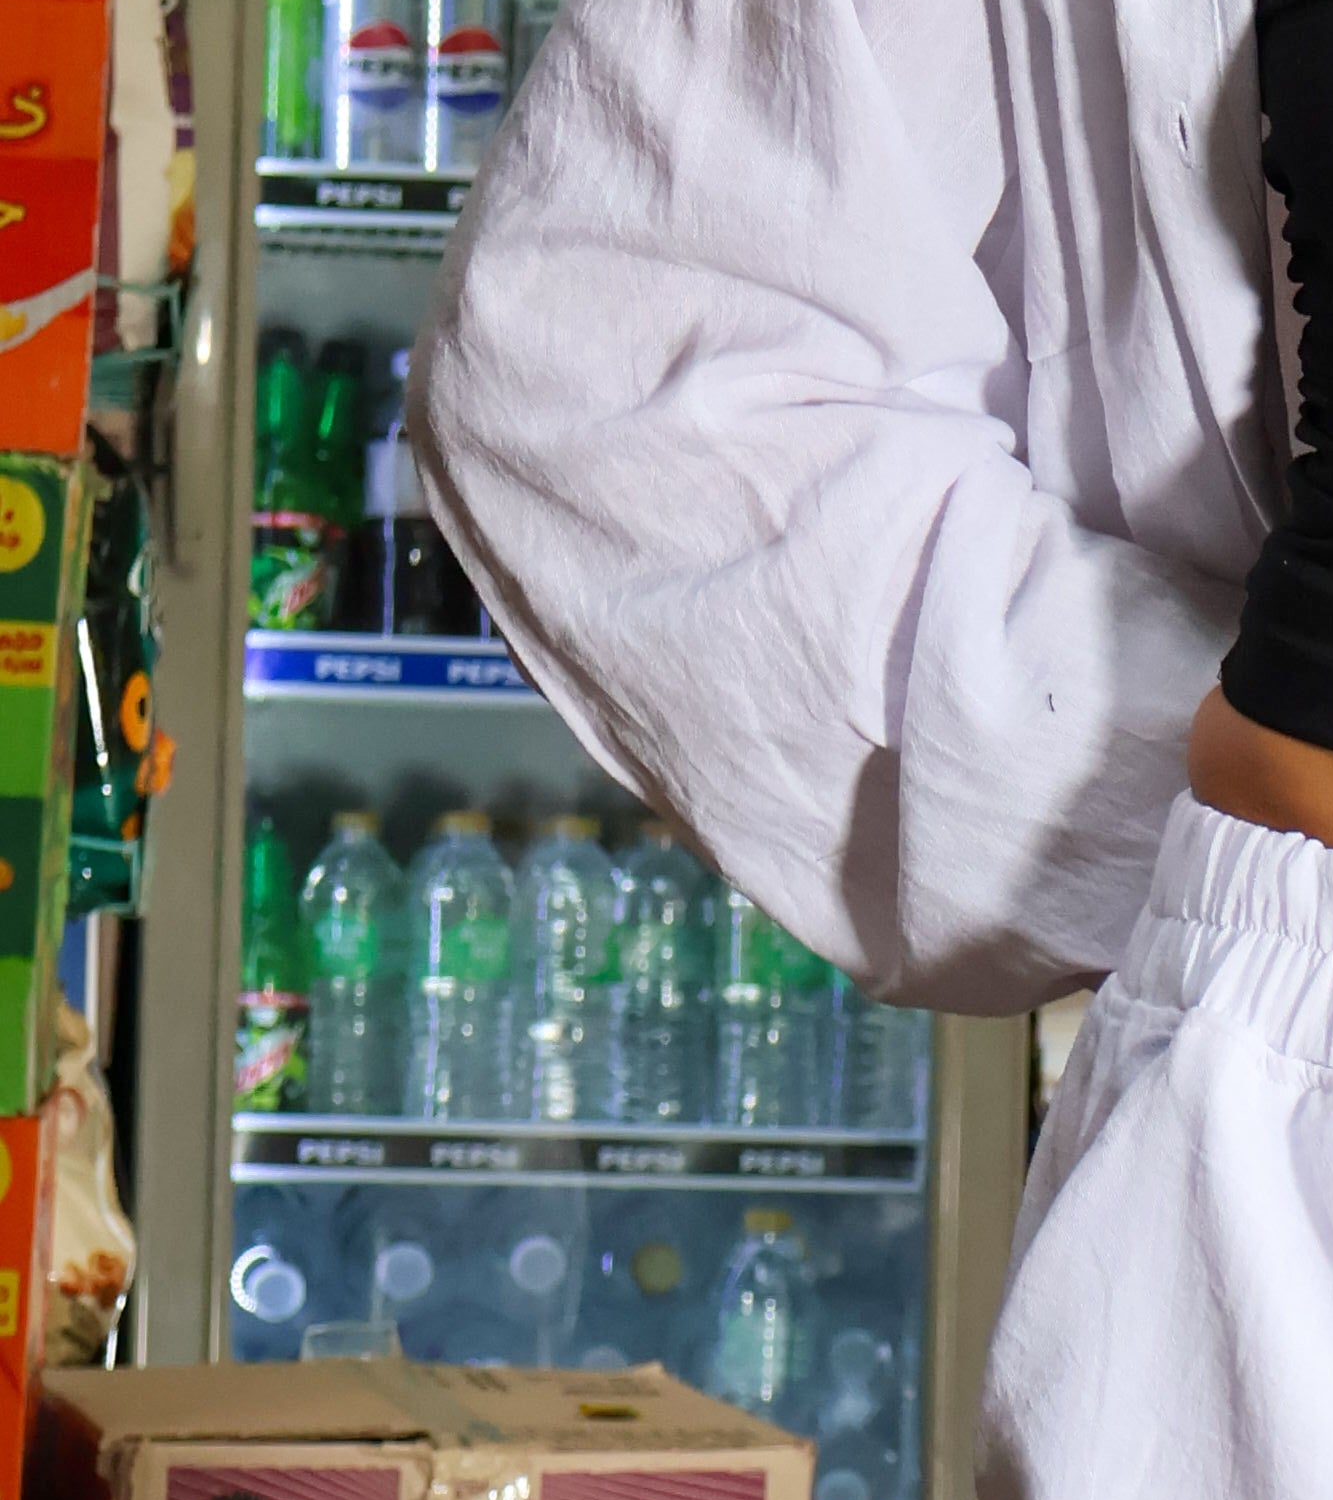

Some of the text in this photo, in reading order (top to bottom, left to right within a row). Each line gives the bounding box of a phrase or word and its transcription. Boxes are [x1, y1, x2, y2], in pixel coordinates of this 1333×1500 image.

[315, 655, 402, 682] PEPSI
[298, 1140, 386, 1166] PEPSI
[430, 1142, 521, 1169] PEPSI
